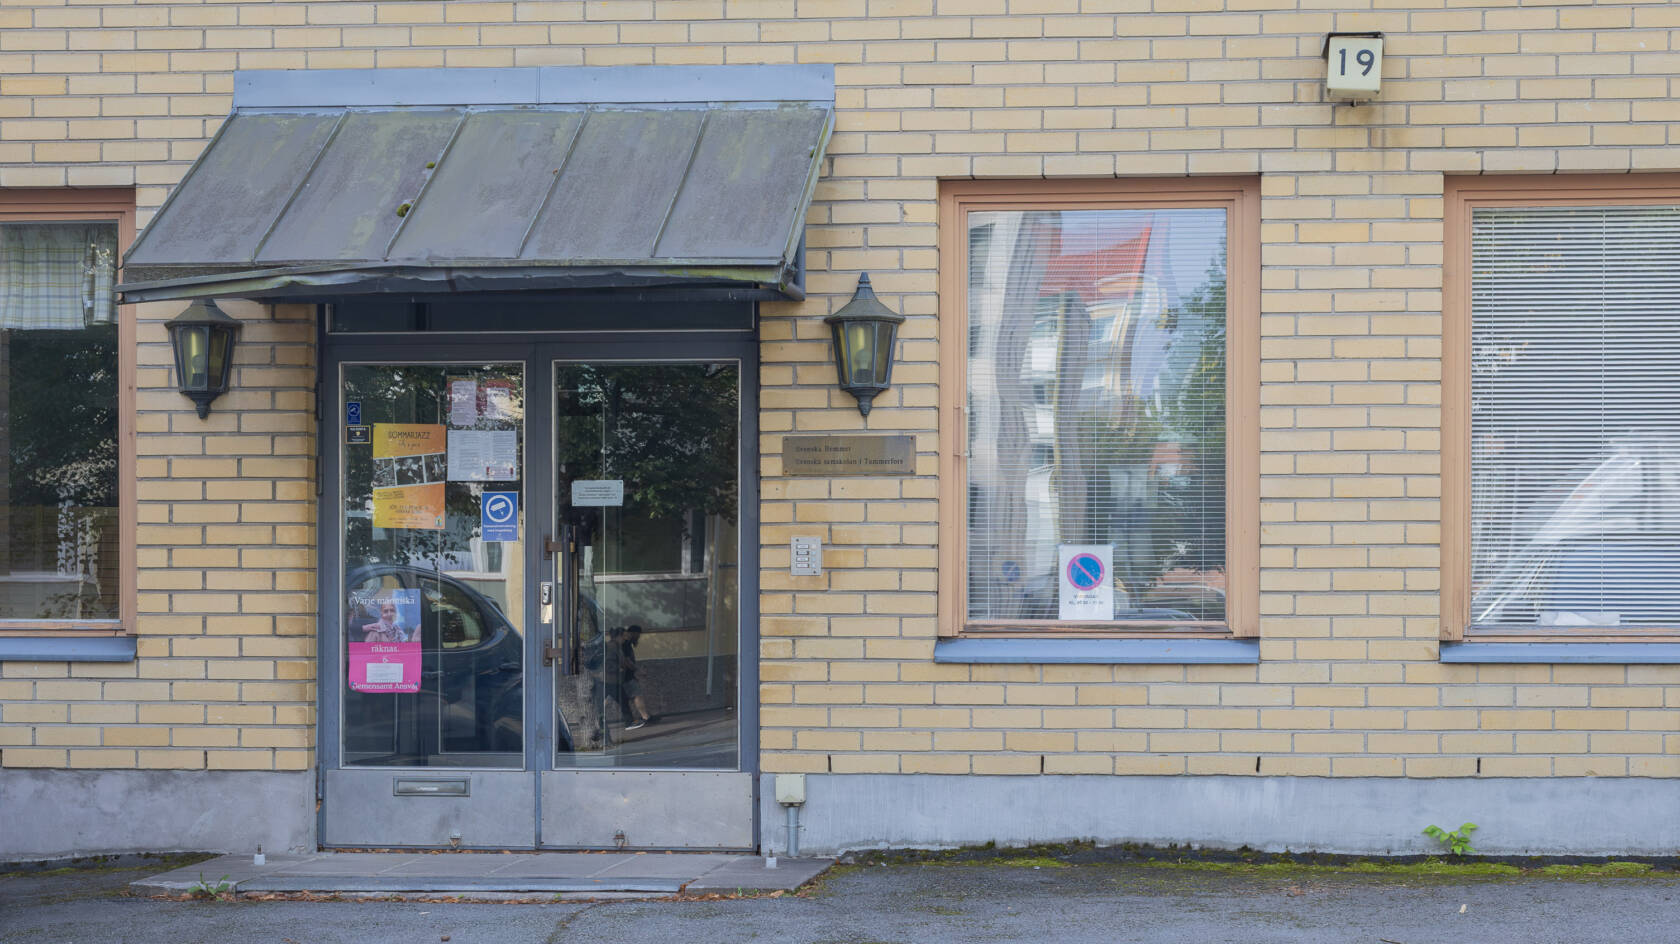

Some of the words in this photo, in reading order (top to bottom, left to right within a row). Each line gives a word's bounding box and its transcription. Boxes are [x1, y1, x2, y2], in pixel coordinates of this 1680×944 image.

[1338, 48, 1375, 77] 19
[795, 457, 822, 465] Svenska
[354, 596, 376, 606] Varje
